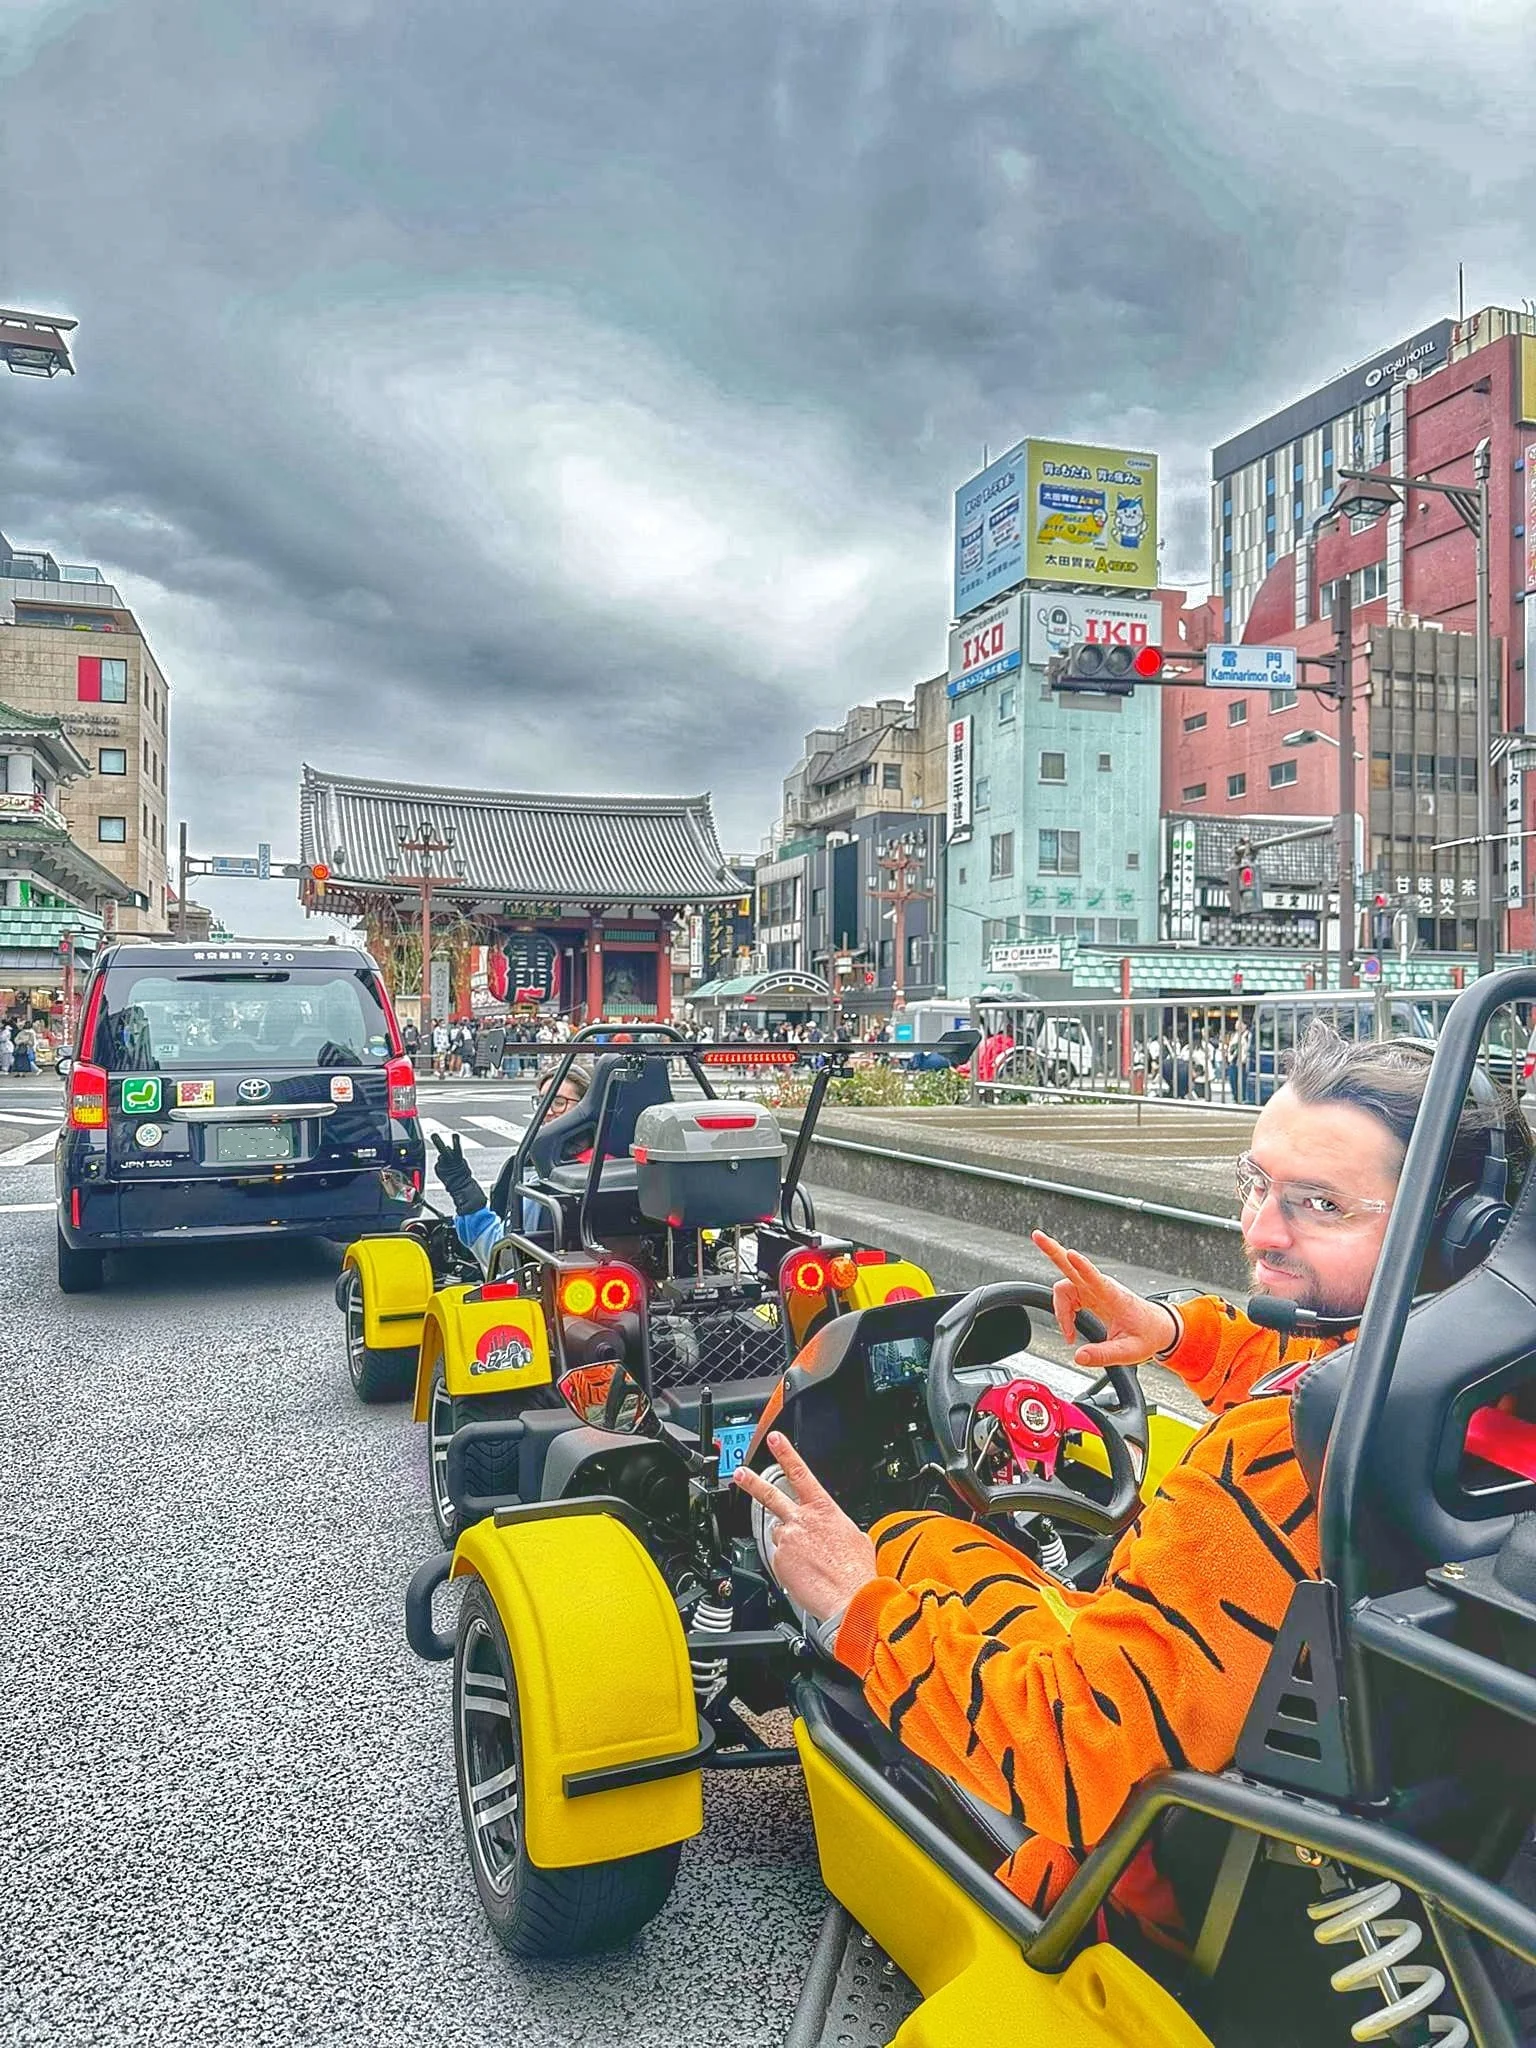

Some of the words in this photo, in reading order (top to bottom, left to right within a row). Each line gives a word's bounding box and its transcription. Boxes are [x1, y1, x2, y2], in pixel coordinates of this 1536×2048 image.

[1407, 341, 1436, 363] HOTEL
[1085, 618, 1148, 645] IKO
[963, 622, 1004, 670] IKO
[1211, 668, 1268, 682] Kaminarimon
[1271, 670, 1292, 683] Gate
[1396, 876, 1477, 896] 甘味喫茶
[247, 951, 295, 962] 7220
[120, 1160, 145, 1169] JPN
[146, 1159, 173, 1168] TAXI
